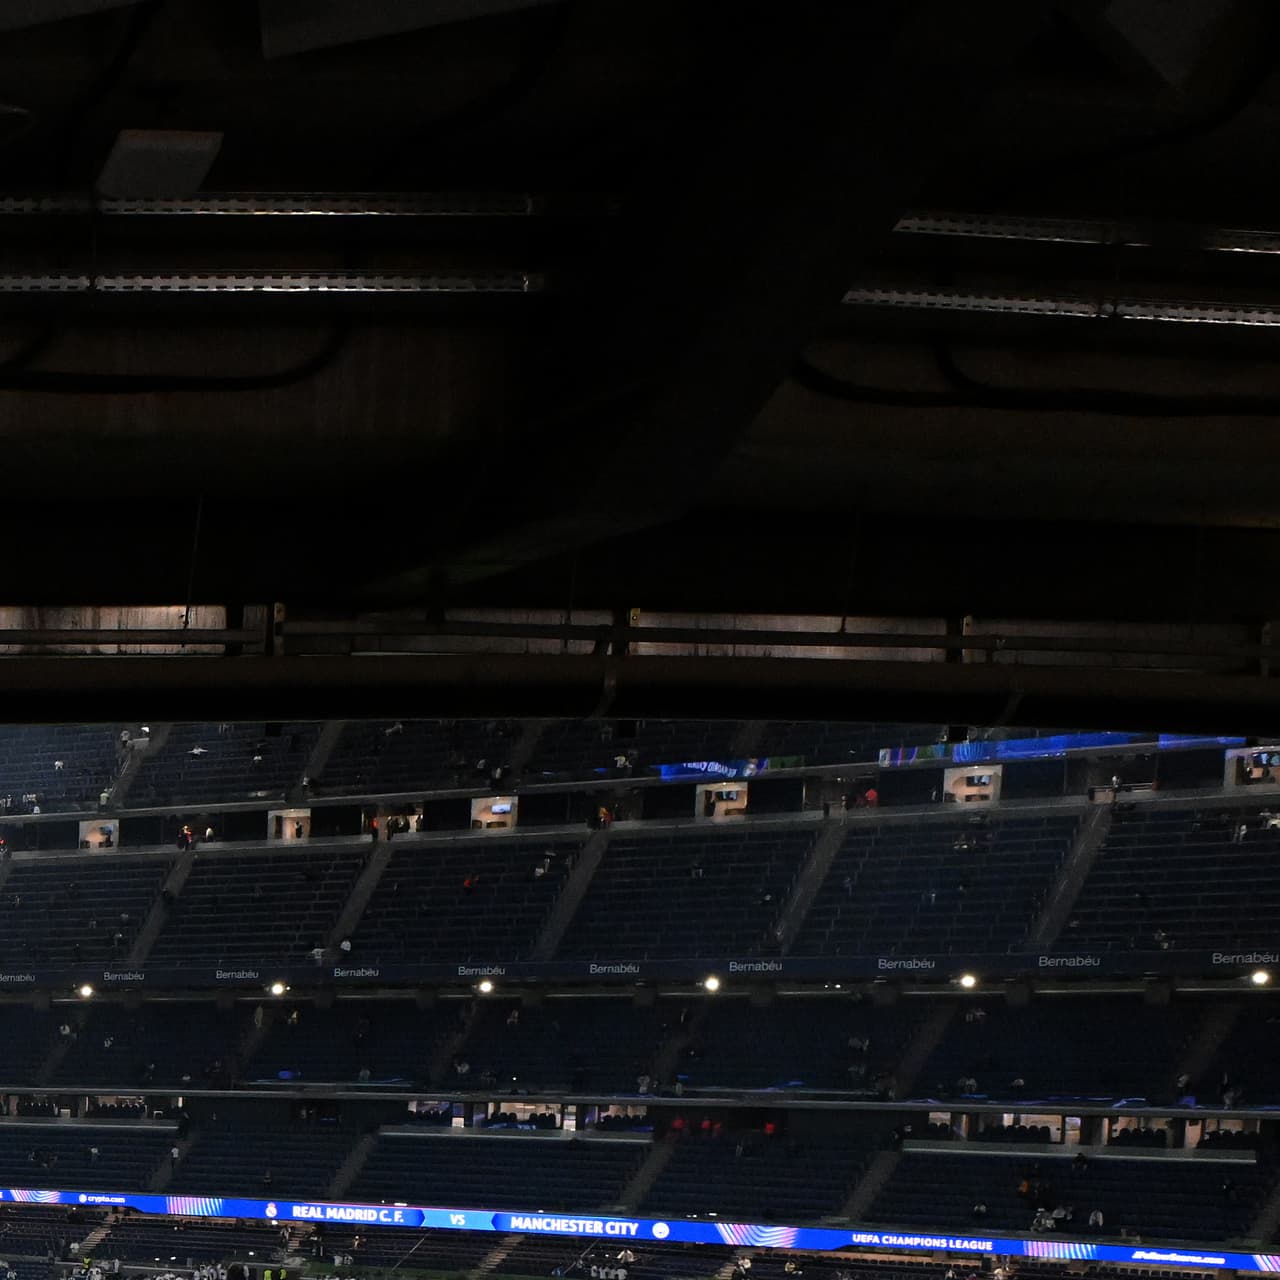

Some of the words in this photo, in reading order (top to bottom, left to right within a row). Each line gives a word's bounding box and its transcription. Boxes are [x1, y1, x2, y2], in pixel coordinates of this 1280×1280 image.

[292, 1205, 324, 1219] REAL
[325, 1207, 377, 1221] MADRID
[450, 1214, 465, 1226] VS
[510, 1216, 604, 1234] MANCHESTER
[605, 1221, 639, 1236] CITY
[852, 1233, 880, 1244] UEFA
[881, 1235, 947, 1248] CHAMPIONS
[948, 1239, 993, 1251] LEAGUE
